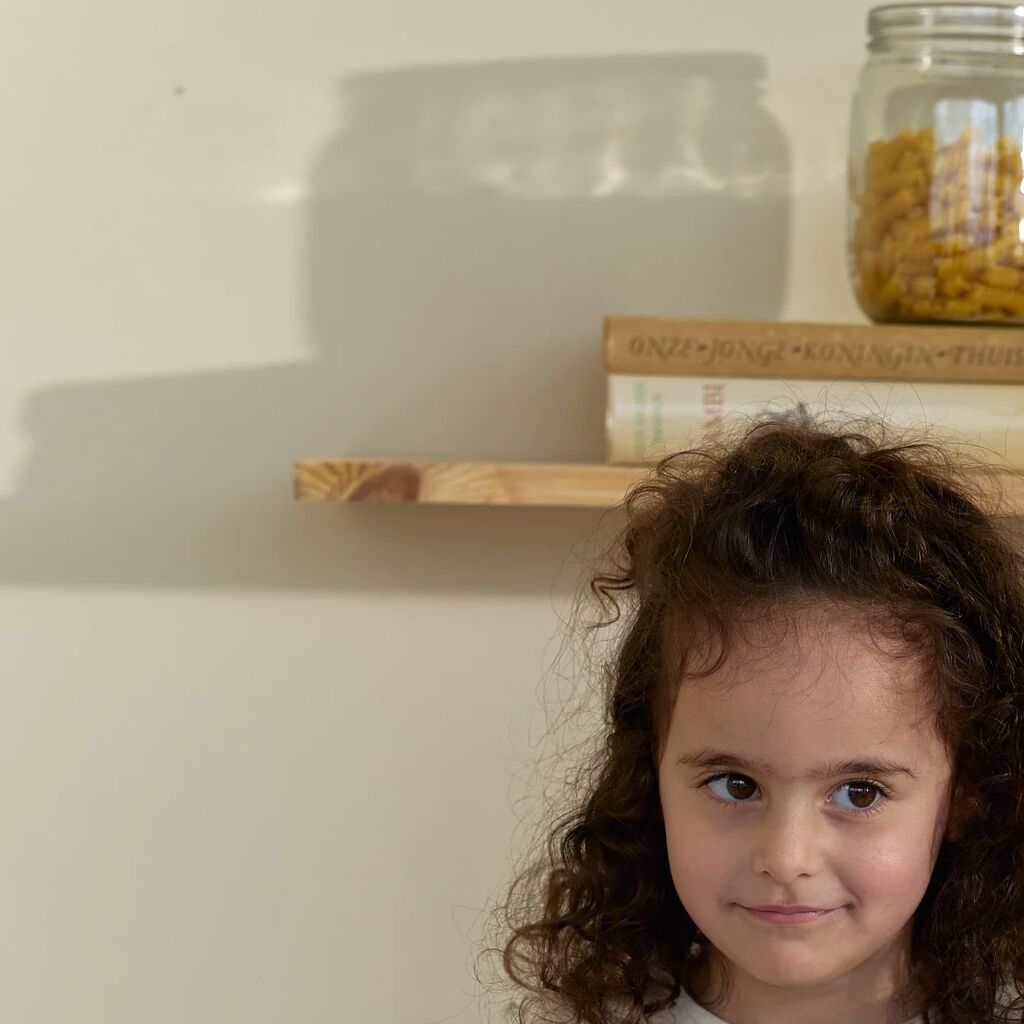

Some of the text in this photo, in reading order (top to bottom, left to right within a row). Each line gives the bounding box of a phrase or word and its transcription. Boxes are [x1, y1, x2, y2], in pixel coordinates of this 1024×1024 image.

[628, 335, 696, 361] ONZE
[702, 337, 786, 367] JONGE
[801, 341, 938, 370] KONINGIN
